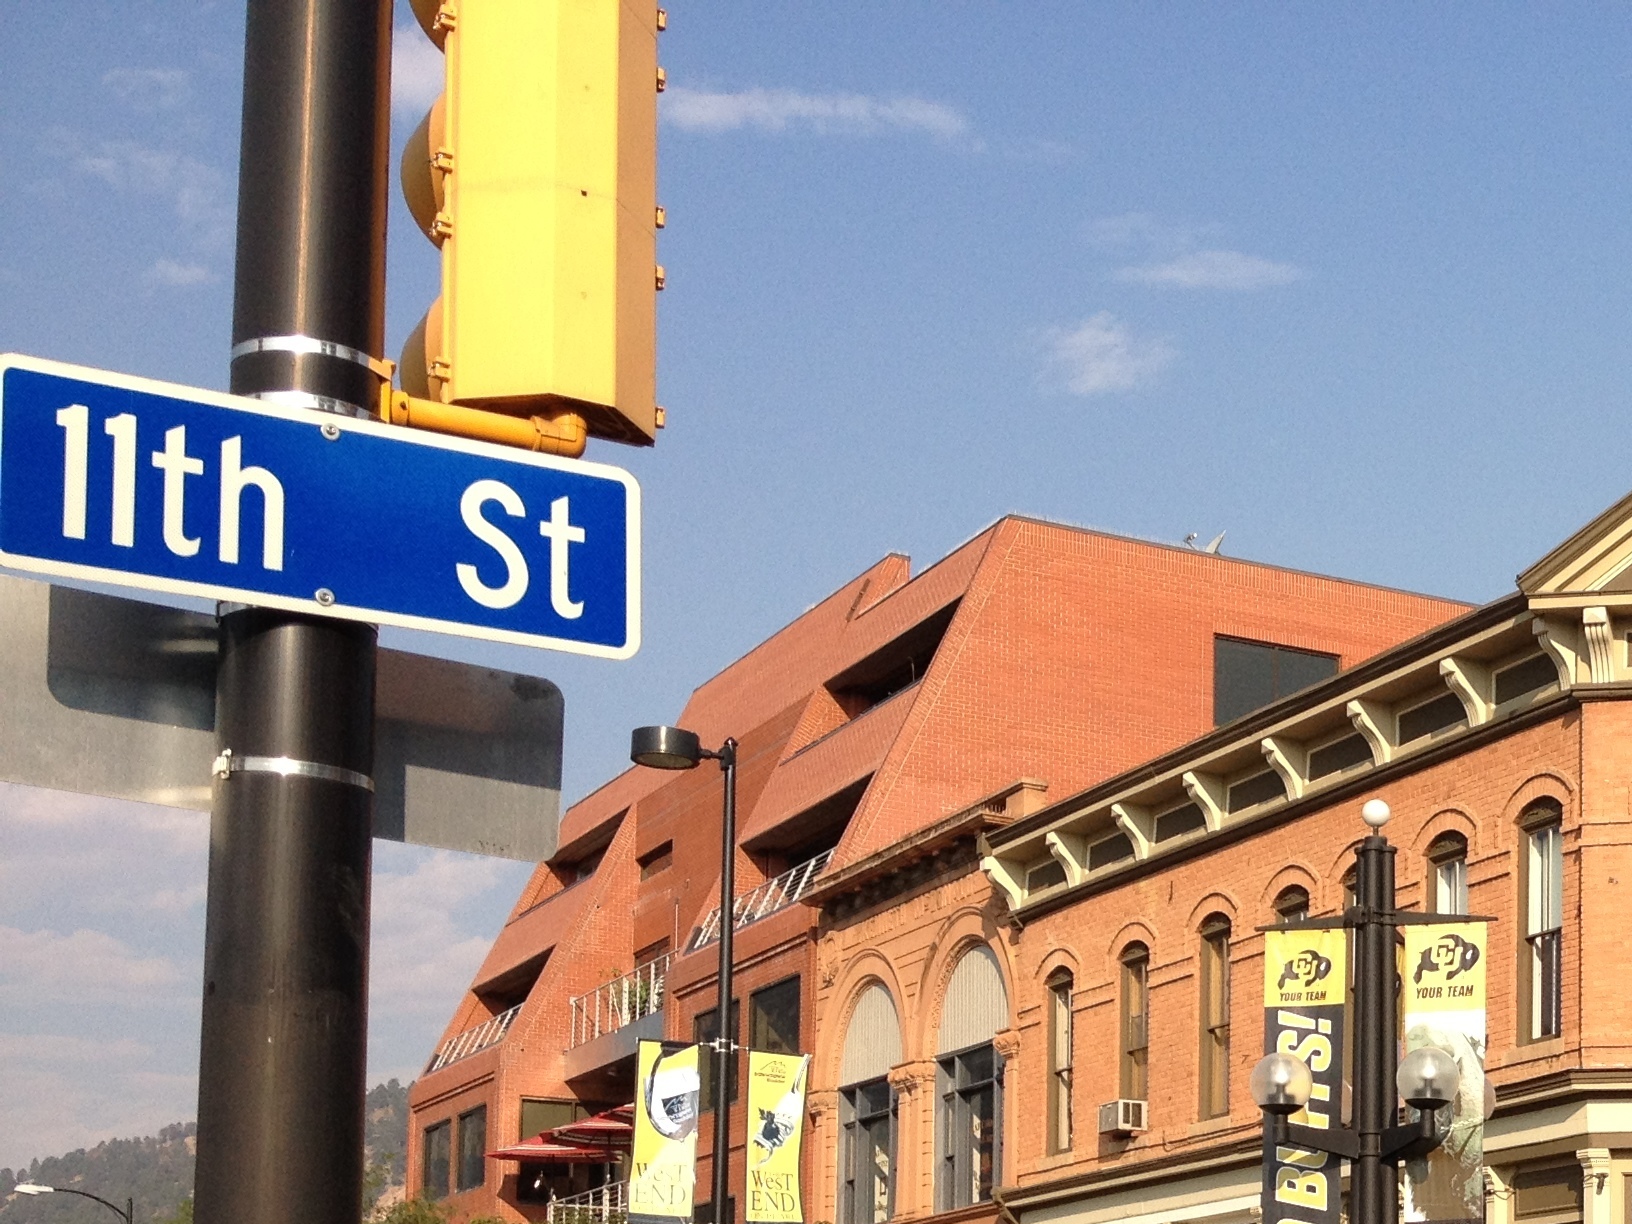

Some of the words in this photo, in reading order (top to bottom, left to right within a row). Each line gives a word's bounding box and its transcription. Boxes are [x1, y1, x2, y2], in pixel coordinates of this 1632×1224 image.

[56, 403, 285, 572] 11th
[456, 479, 586, 619] St
[1280, 992, 1303, 1001] YOUR
[1306, 991, 1327, 1001] TEAM
[1416, 987, 1443, 999] YOUR
[1447, 985, 1474, 997] TEAM
[635, 1183, 686, 1205] END
[751, 1190, 795, 1212] END
